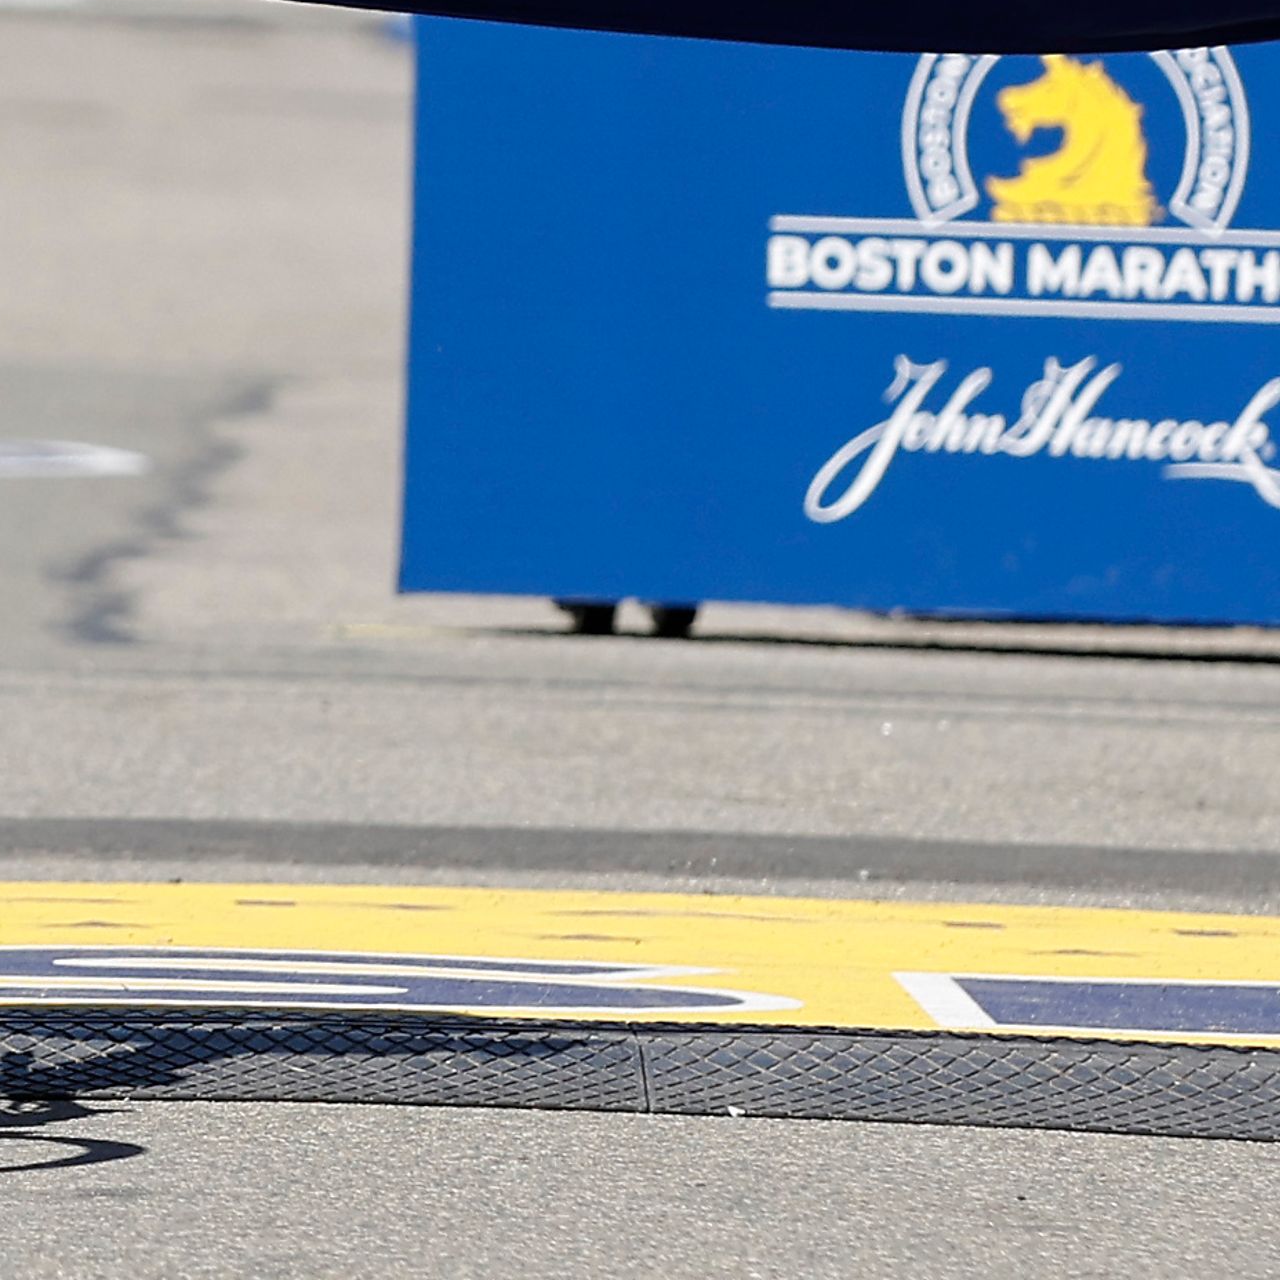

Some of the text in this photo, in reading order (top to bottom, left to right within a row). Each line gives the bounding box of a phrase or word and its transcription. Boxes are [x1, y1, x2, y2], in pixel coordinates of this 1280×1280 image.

[767, 233, 1015, 295] BOSTON
[804, 354, 1280, 523] John Hancock
